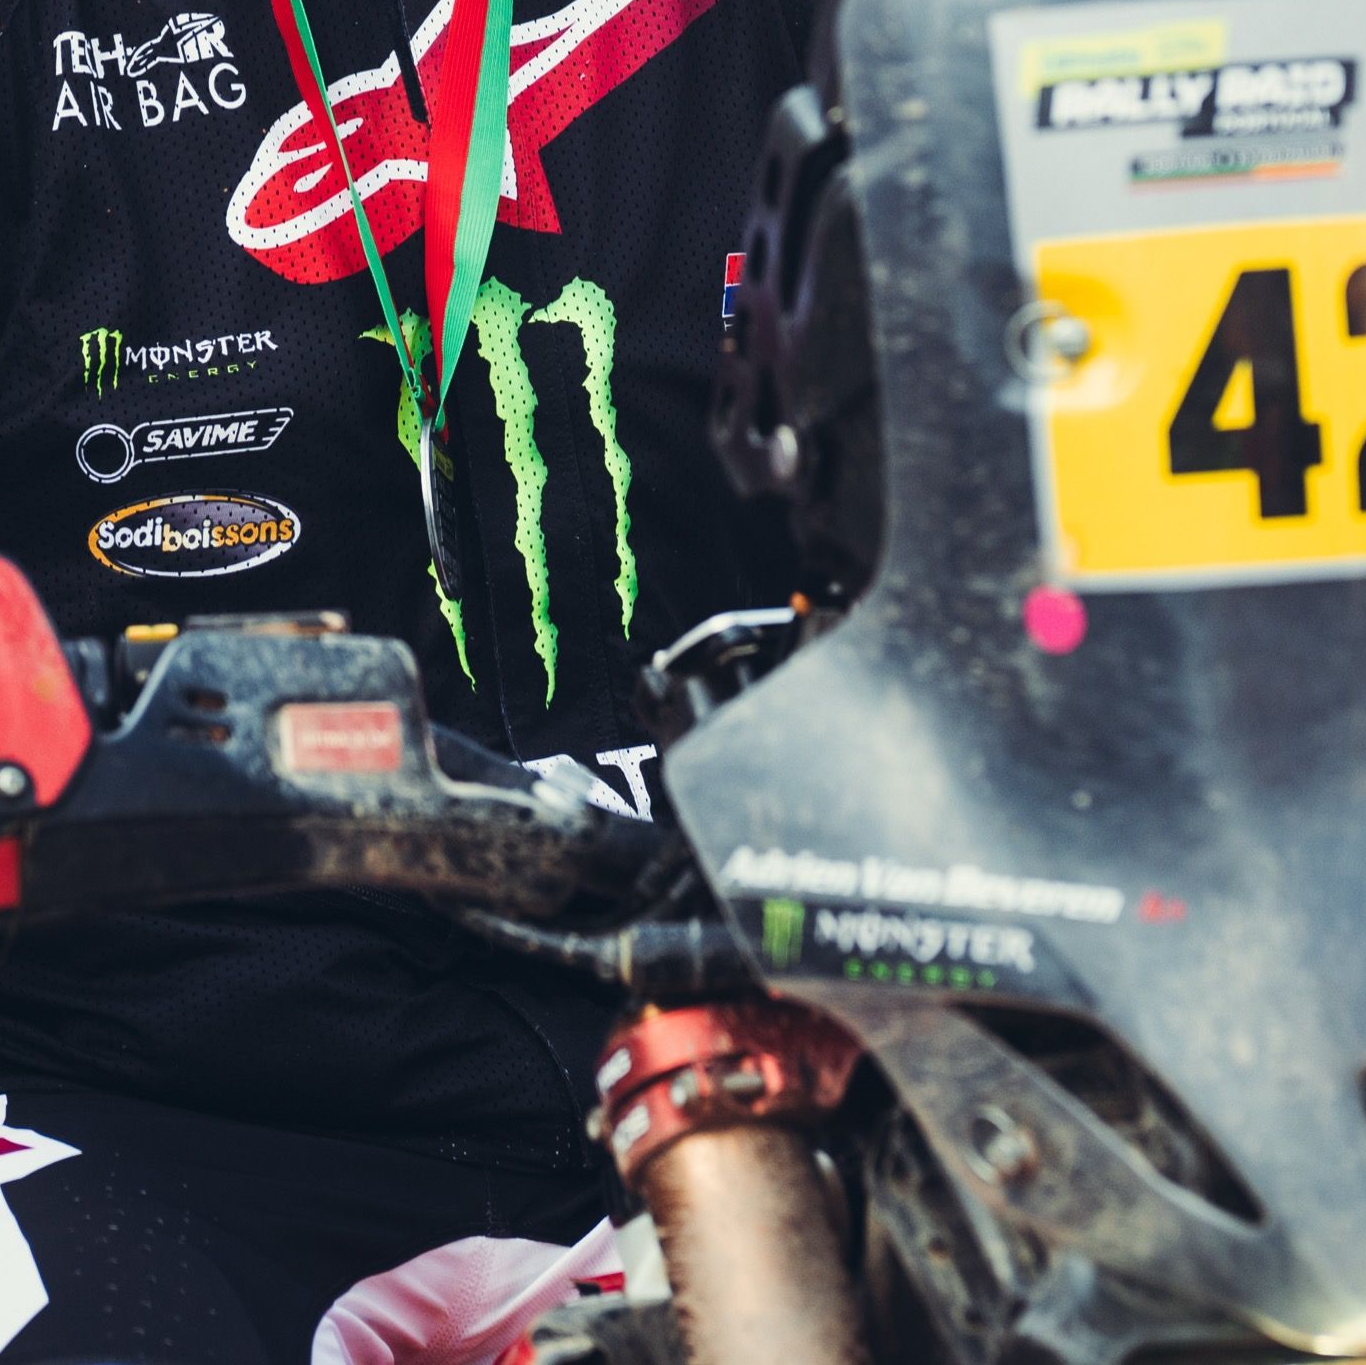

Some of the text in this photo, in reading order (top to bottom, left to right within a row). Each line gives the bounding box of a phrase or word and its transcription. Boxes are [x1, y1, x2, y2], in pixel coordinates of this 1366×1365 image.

[125, 330, 279, 371] MONSTER
[148, 360, 257, 383] ENERGY
[143, 420, 258, 453] SAVIME
[98, 517, 293, 552] Sodiboissons
